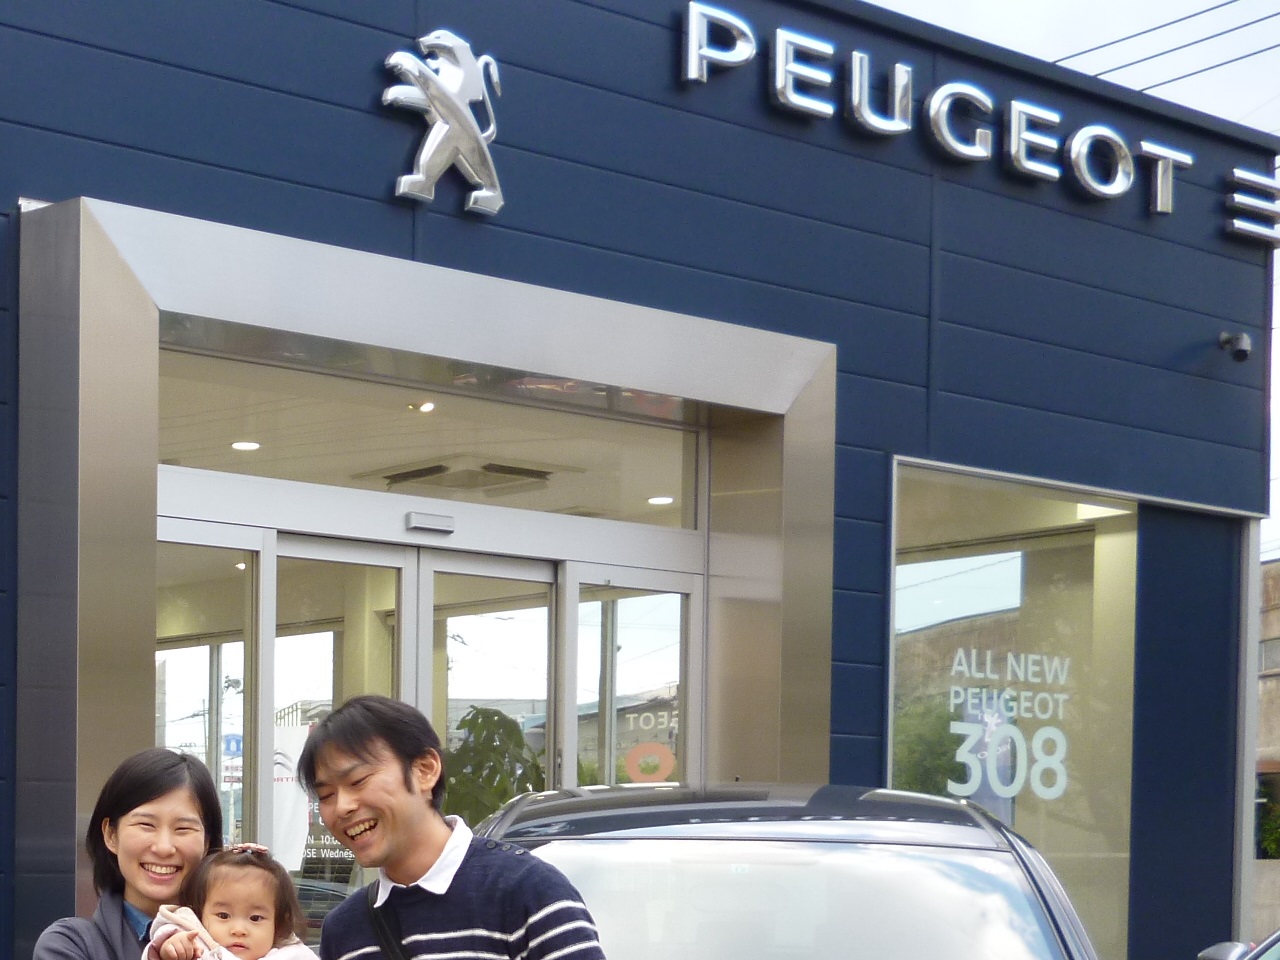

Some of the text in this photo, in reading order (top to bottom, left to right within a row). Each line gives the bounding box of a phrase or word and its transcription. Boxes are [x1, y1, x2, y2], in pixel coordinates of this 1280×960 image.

[681, 0, 1194, 214] PEUGEOT
[950, 648, 1071, 684] ALL NEW
[949, 686, 1069, 719] PEUGEOT
[947, 721, 1067, 800] 308
[321, 848, 355, 858] Wednes
